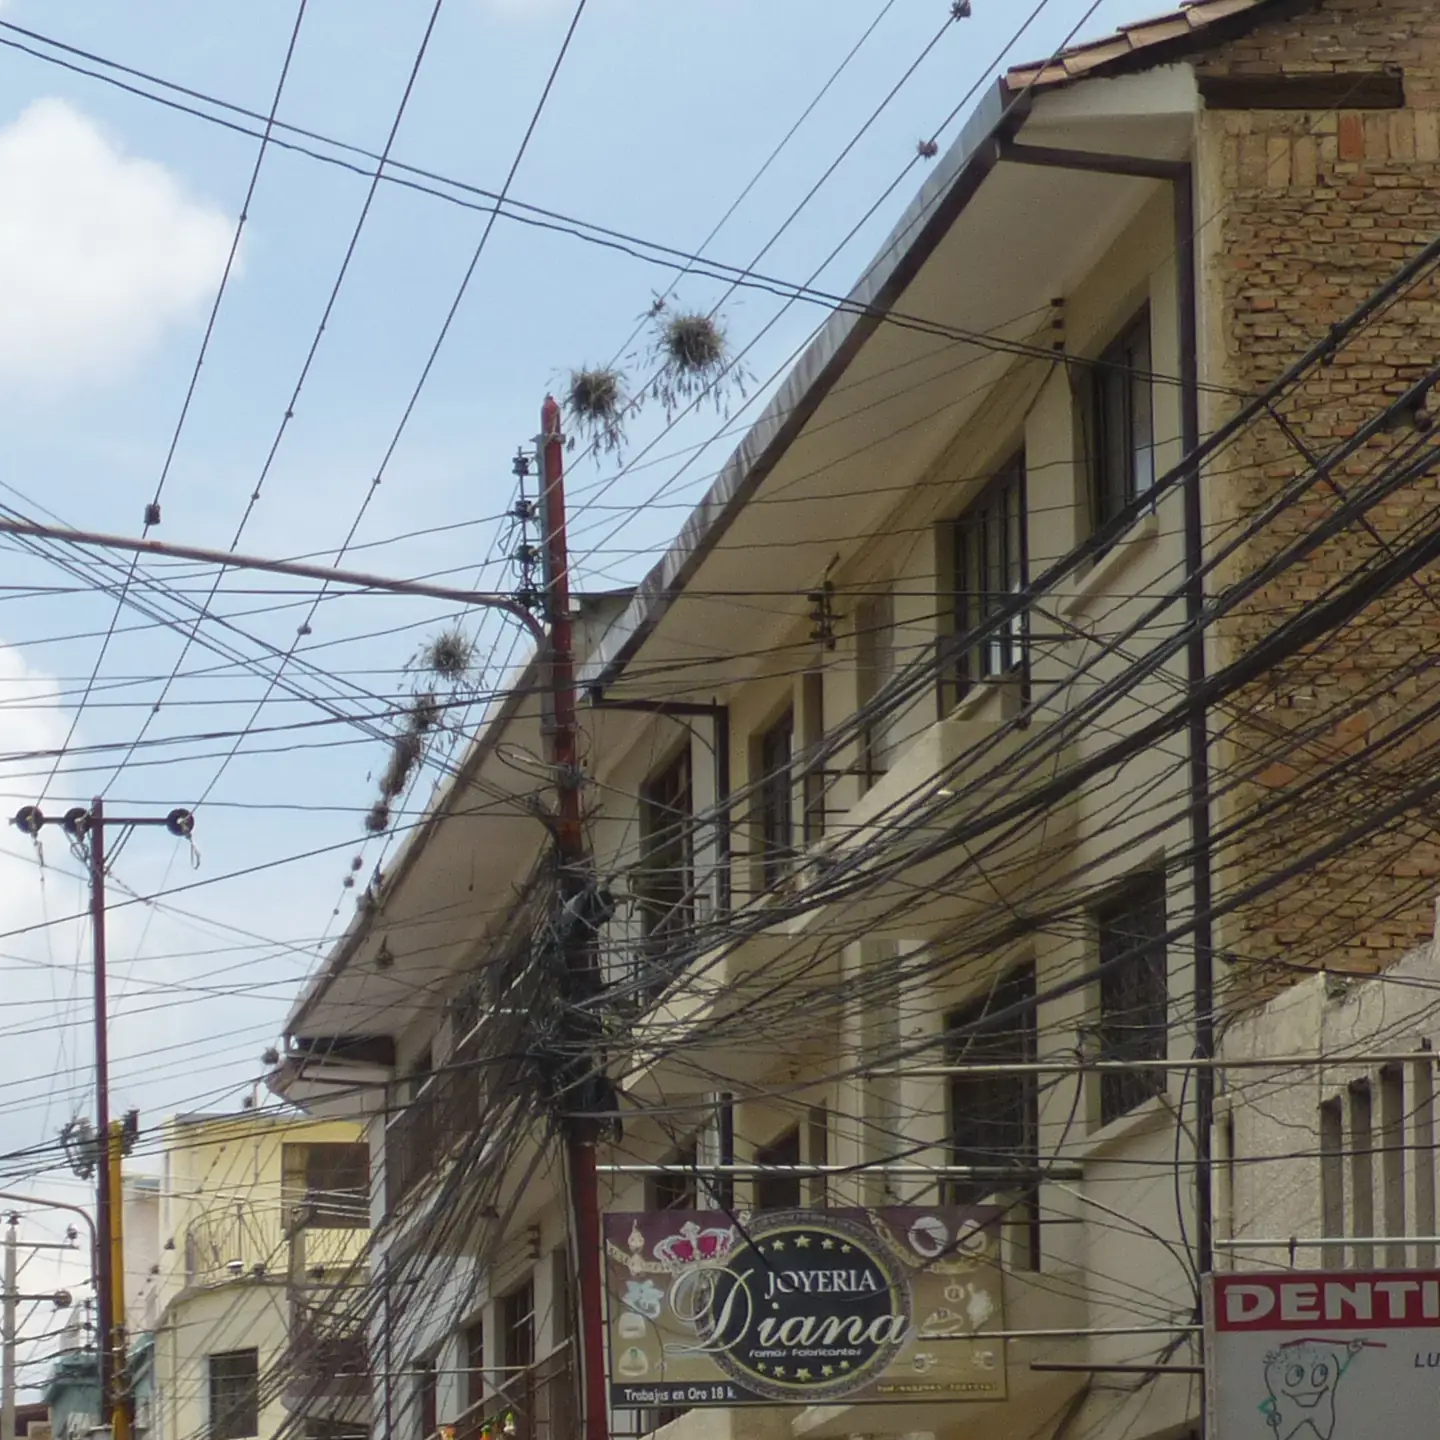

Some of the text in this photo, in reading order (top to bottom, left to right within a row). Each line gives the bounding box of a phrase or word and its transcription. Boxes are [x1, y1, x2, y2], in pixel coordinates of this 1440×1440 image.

[764, 1268, 878, 1299] JOYERIA
[663, 1266, 918, 1353] Diana
[687, 1387, 708, 1400] Oro
[711, 1386, 724, 1399] 18
